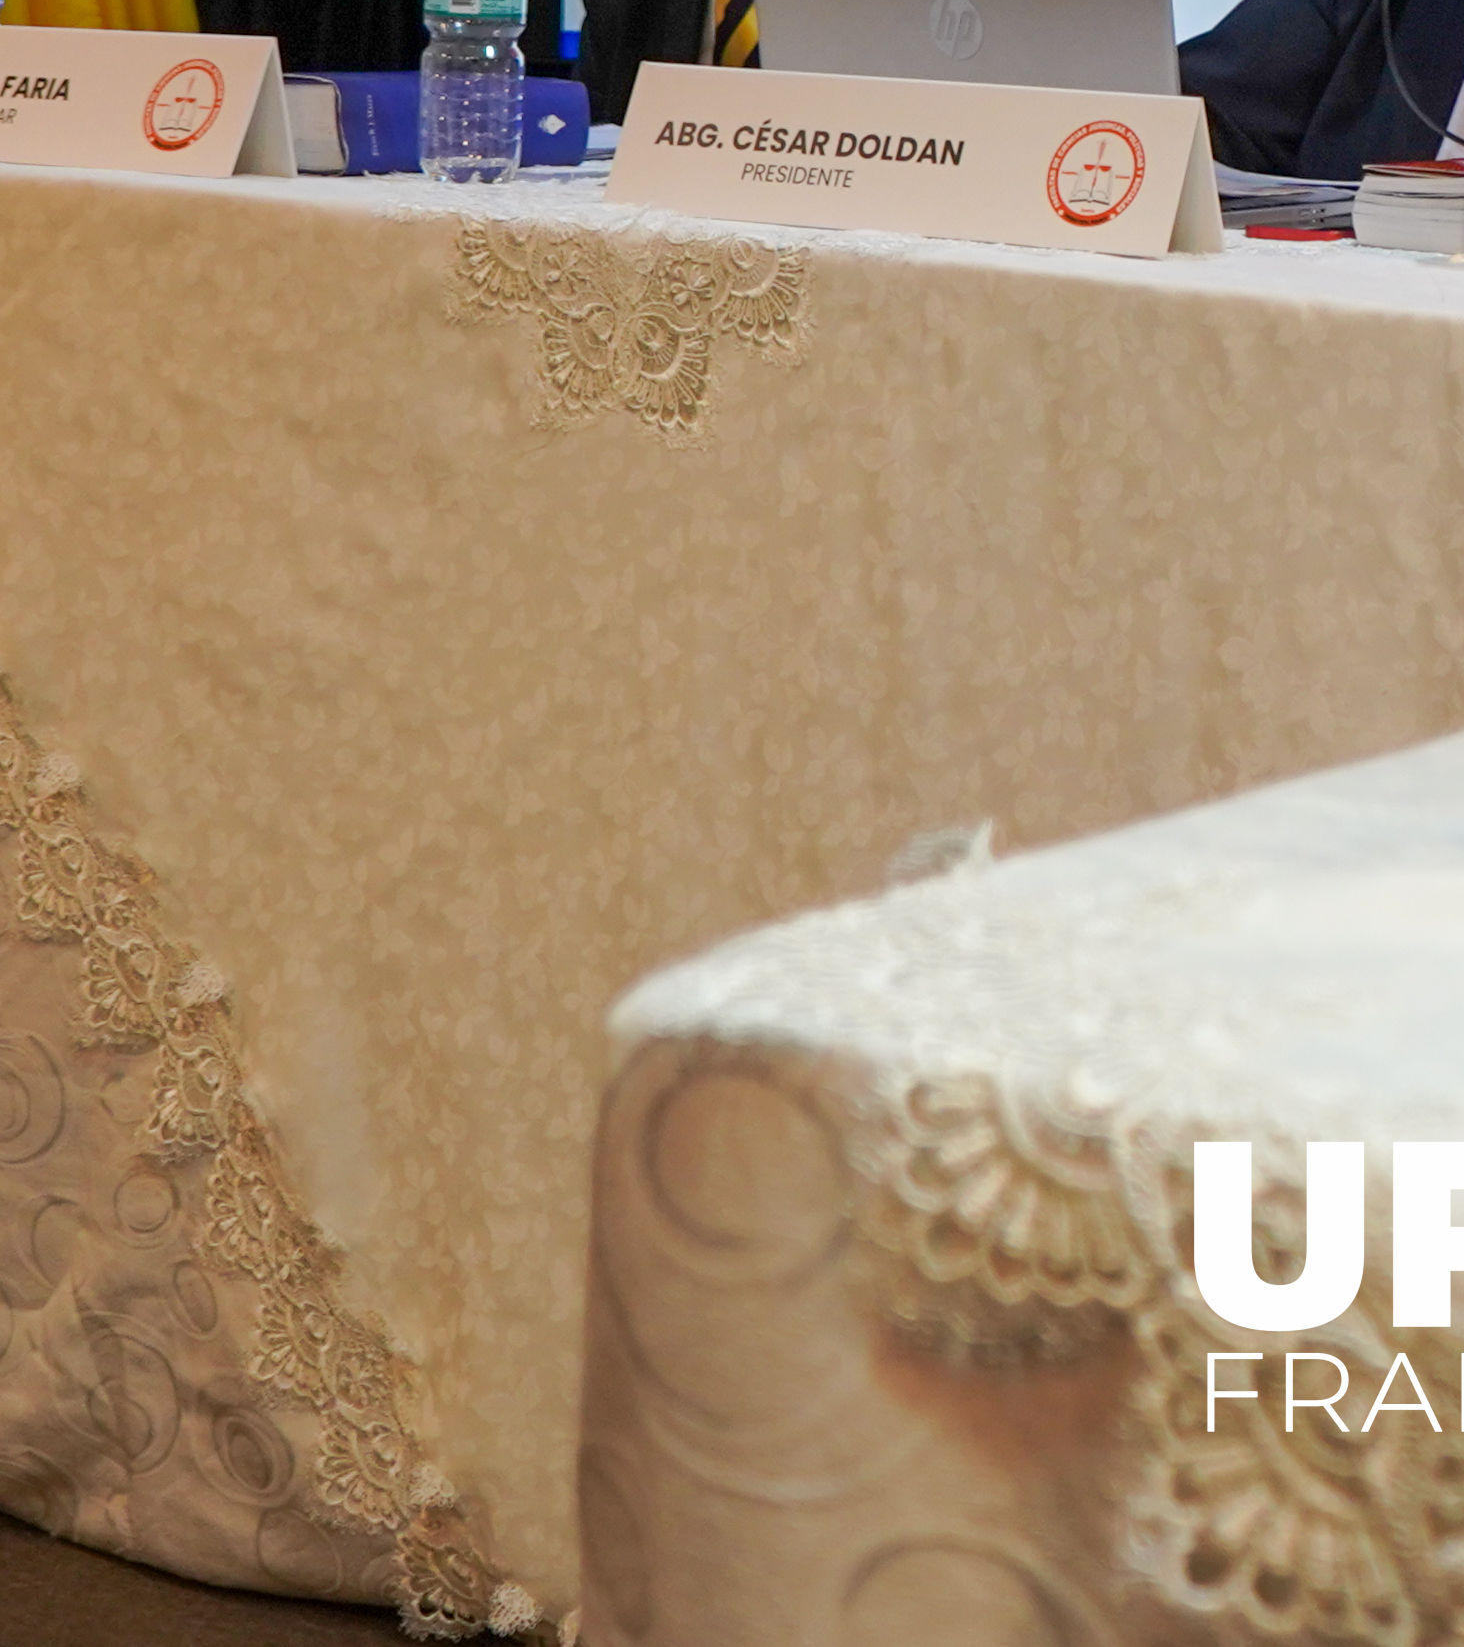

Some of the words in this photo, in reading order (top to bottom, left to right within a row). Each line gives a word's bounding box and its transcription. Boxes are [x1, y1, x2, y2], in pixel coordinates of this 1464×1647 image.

[0, 75, 71, 101] FARIA
[654, 120, 724, 149] ABG.
[733, 119, 830, 156] CÉSAR
[835, 132, 964, 166] DOLDAN
[741, 162, 854, 188] PRESIDENTE
